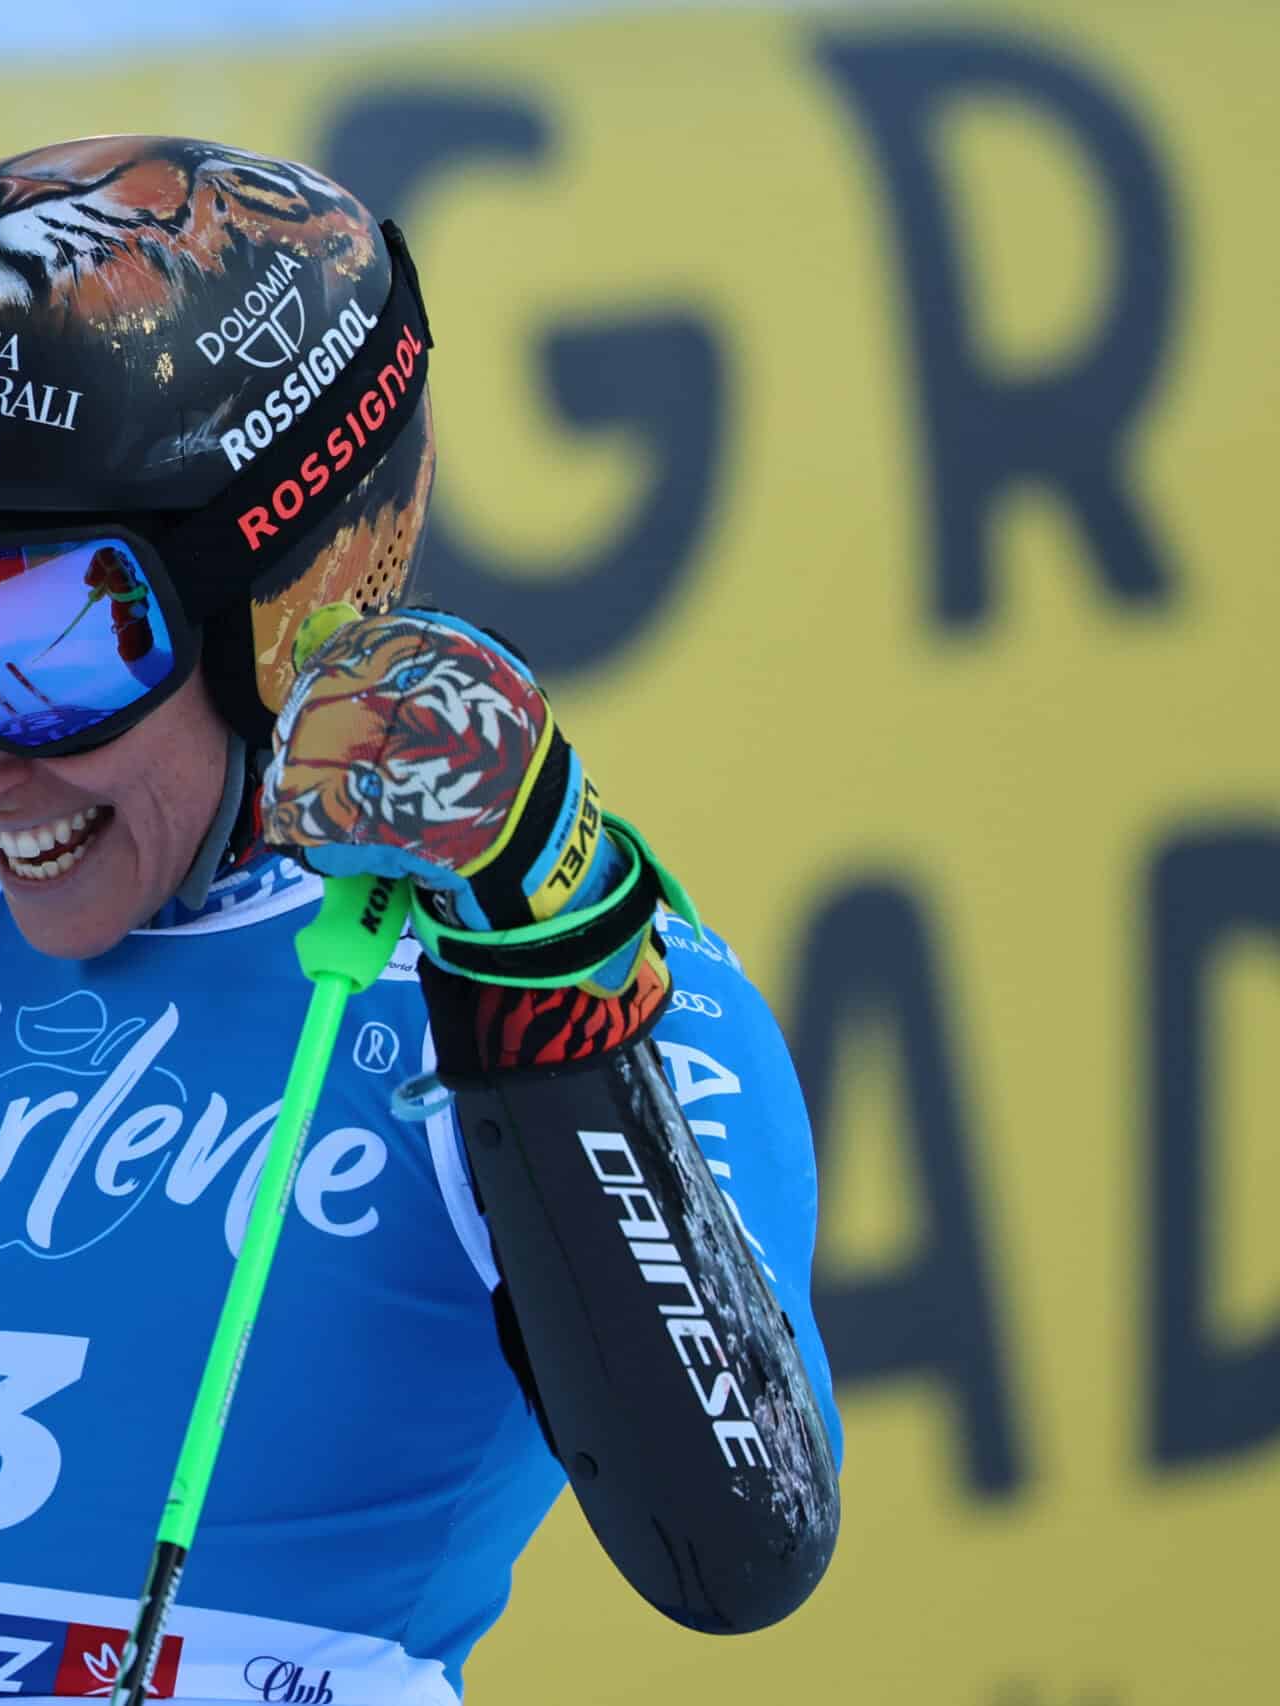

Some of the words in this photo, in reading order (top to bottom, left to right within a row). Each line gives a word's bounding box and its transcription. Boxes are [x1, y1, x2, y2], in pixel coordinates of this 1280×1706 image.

[195, 251, 303, 365] DOLOMIA
[220, 299, 378, 471] ROSSIGNOL
[237, 325, 422, 550] ROSSIGNOL
[547, 777, 600, 889] LEVEL
[576, 1130, 773, 1469] DAINESE
[243, 1655, 333, 1705] Club
